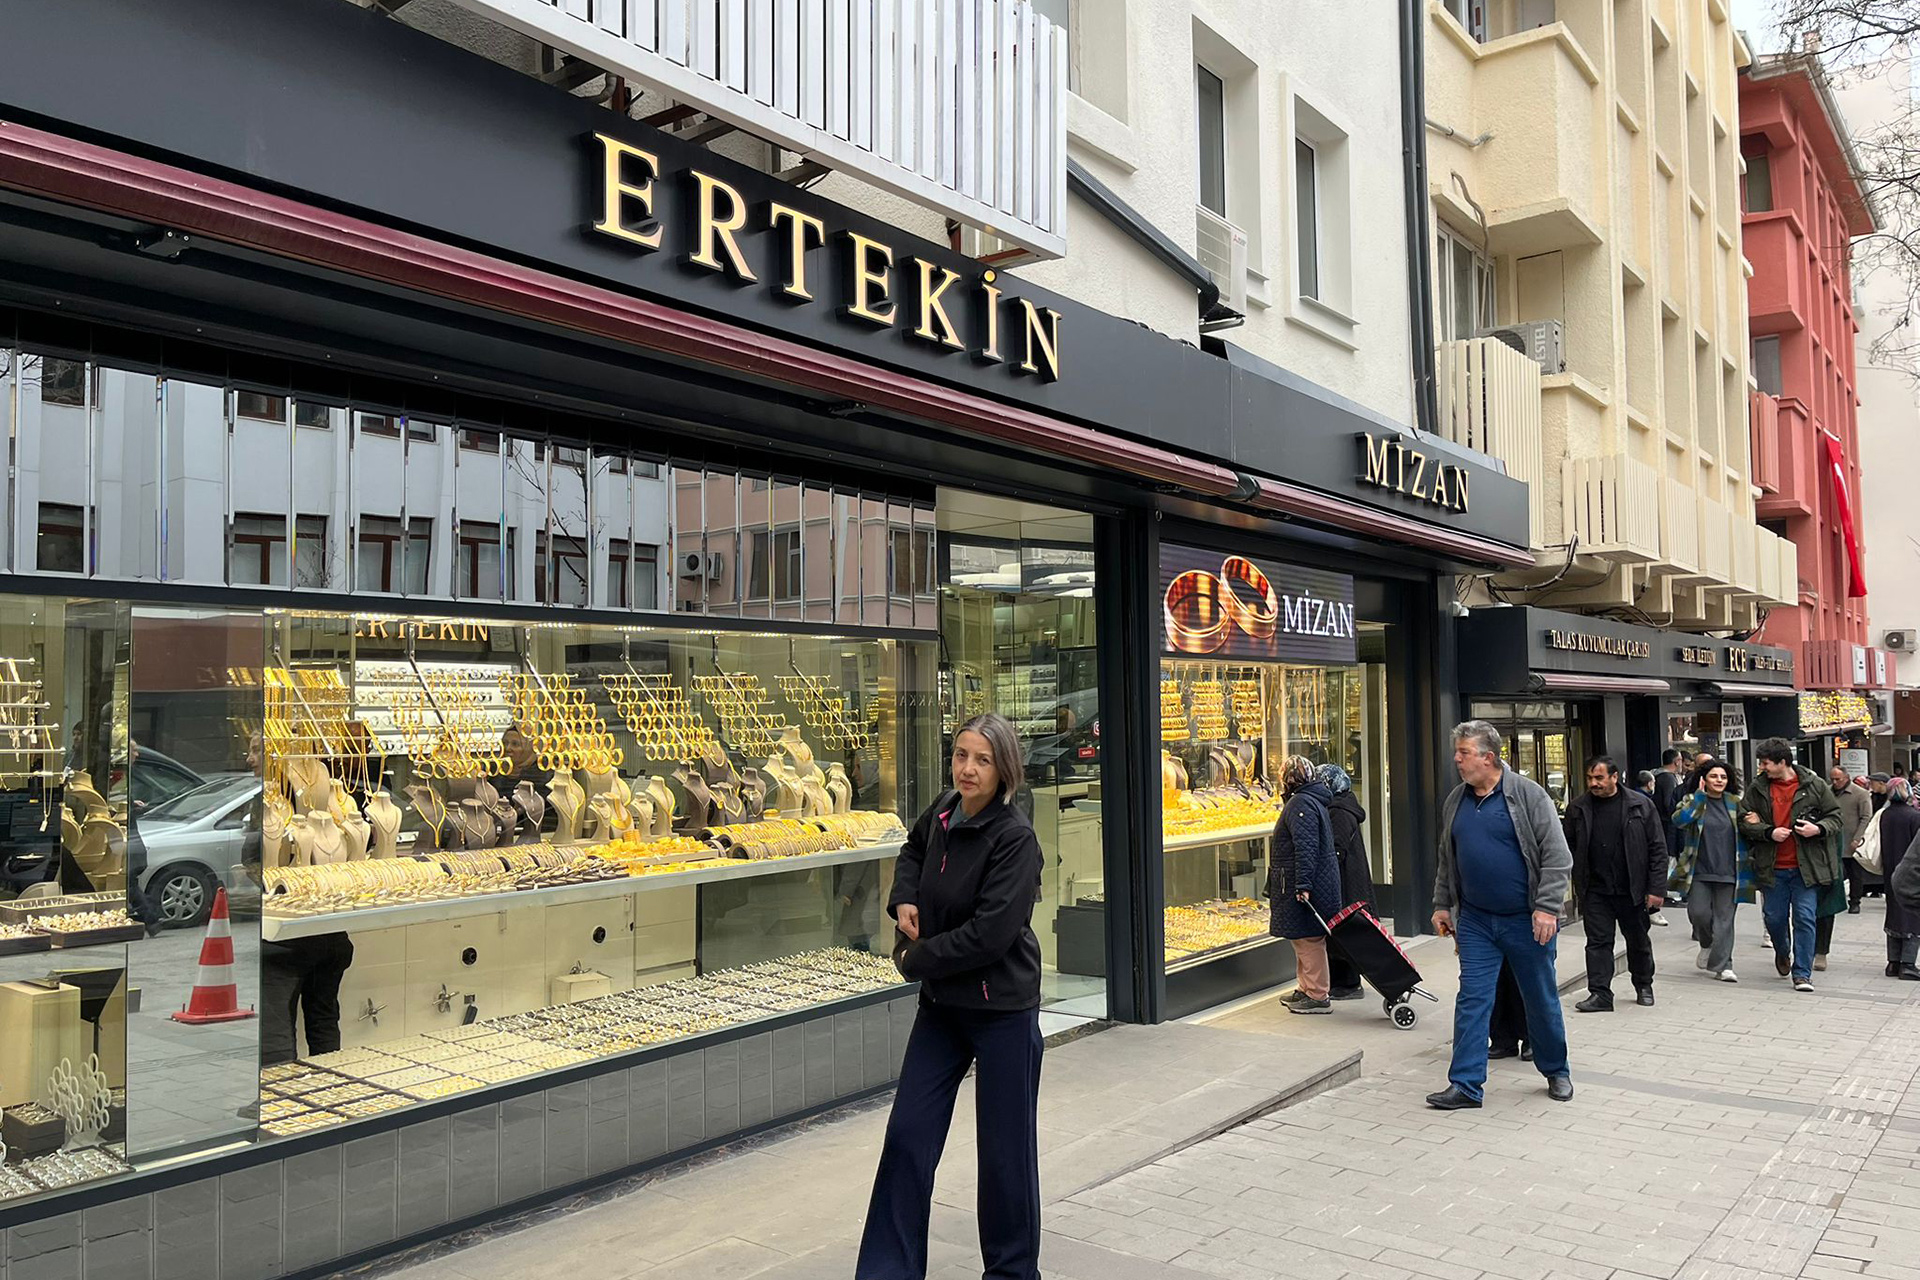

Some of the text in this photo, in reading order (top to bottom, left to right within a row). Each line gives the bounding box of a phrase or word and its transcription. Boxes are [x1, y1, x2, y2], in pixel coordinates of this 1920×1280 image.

[593, 132, 1063, 381] ERTEKİN
[1365, 432, 1470, 513] MİZAN
[1283, 589, 1354, 638] MİZAN
[1551, 629, 1576, 650] TALAS
[1729, 647, 1747, 672] ECE
